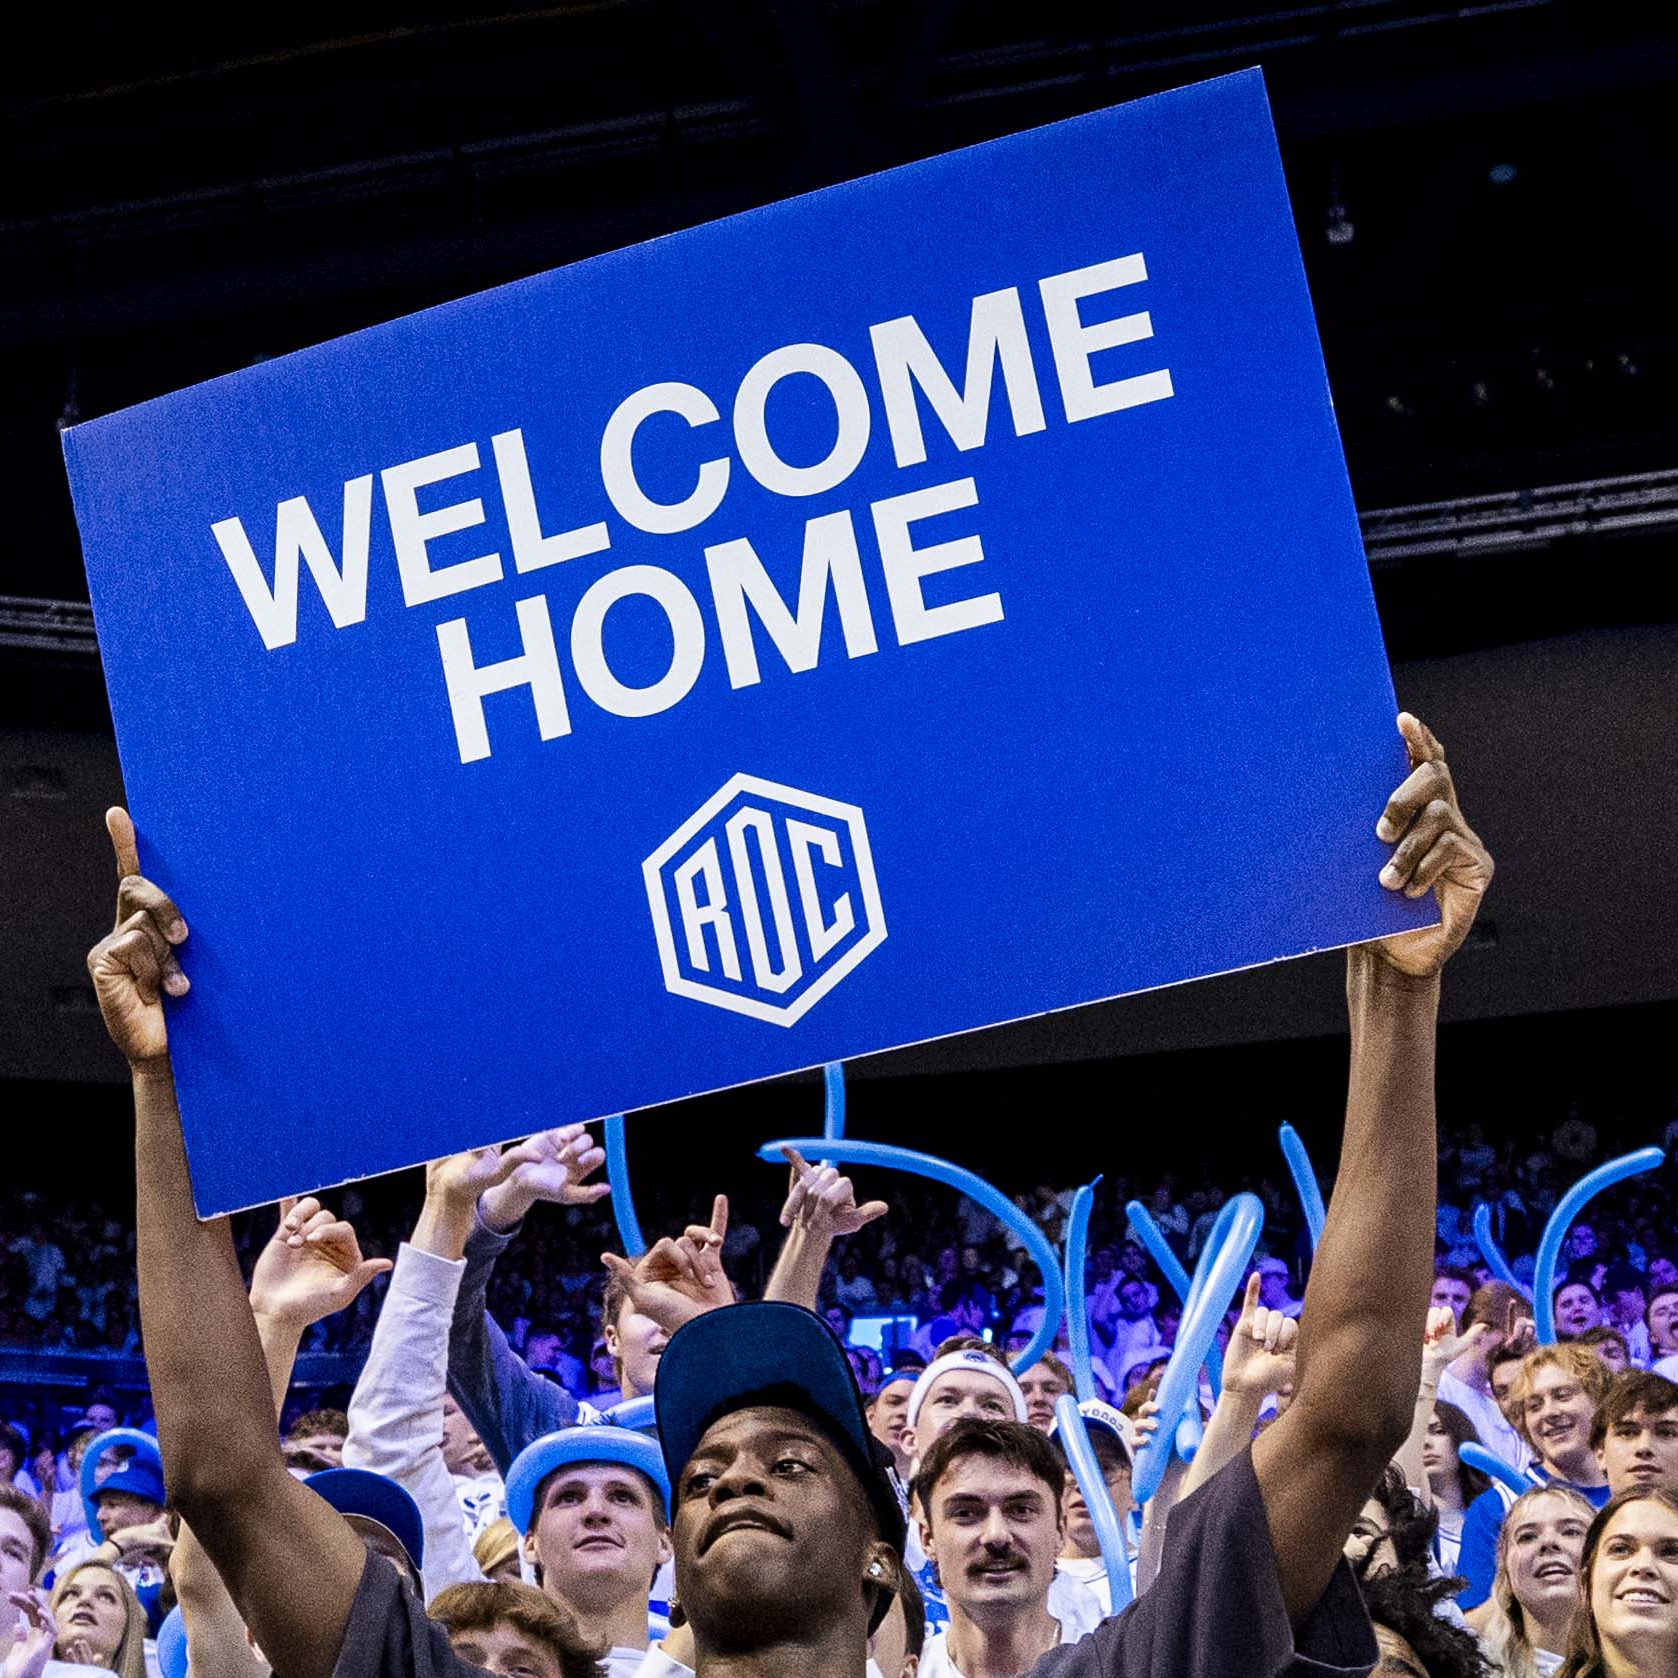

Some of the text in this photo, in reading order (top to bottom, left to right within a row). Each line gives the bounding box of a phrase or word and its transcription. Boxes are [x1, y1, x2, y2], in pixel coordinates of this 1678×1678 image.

[211, 252, 1176, 652] WELCOME
[435, 476, 1005, 765] HOME
[670, 804, 859, 994] ROC
